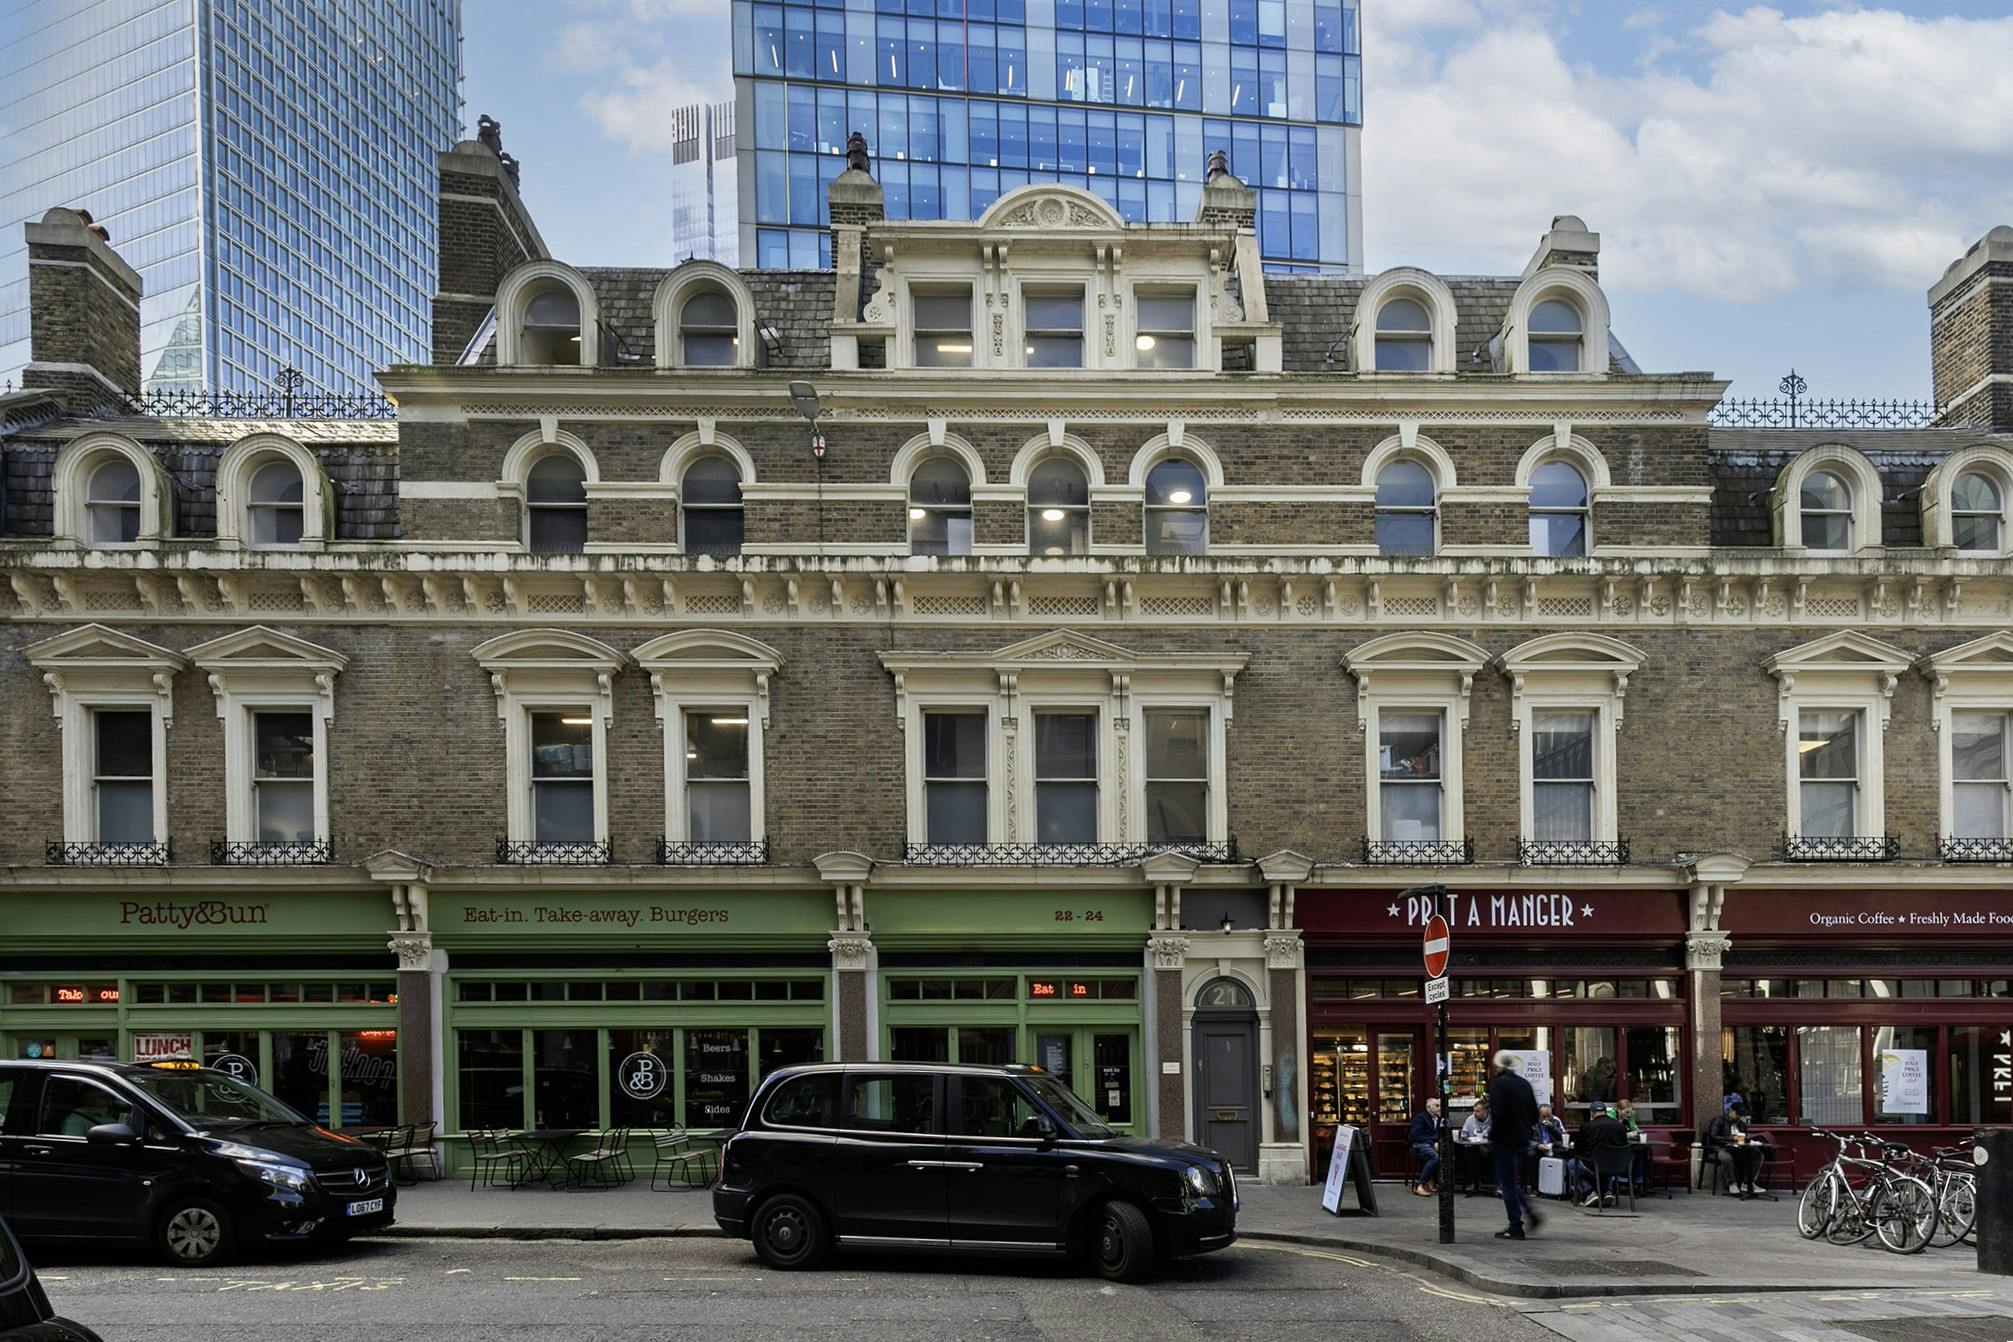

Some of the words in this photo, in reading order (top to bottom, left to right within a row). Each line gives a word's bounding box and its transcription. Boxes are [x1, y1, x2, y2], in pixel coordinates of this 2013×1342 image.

[1408, 894, 1458, 926] PRT
[1467, 895, 1480, 926] A
[1491, 894, 1574, 926] MANGER
[464, 907, 528, 923] Eat-in.
[534, 906, 644, 927] Take-away.
[649, 906, 729, 926] Burgers
[1809, 912, 1855, 927] Organic
[1857, 911, 1895, 925] Coffee
[1909, 912, 1950, 927] Freshly
[1952, 911, 1986, 925] Made
[1033, 983, 1054, 994] Eat
[1073, 983, 1087, 994] in
[1428, 980, 1446, 991] Except
[58, 989, 84, 1000] Tak
[1213, 986, 1235, 1005] 21
[1429, 990, 1446, 1002] cycles
[136, 1038, 191, 1056] LUNCH
[703, 1043, 731, 1053] Beers
[701, 1073, 736, 1083] Shakes
[704, 1104, 731, 1114] Sides
